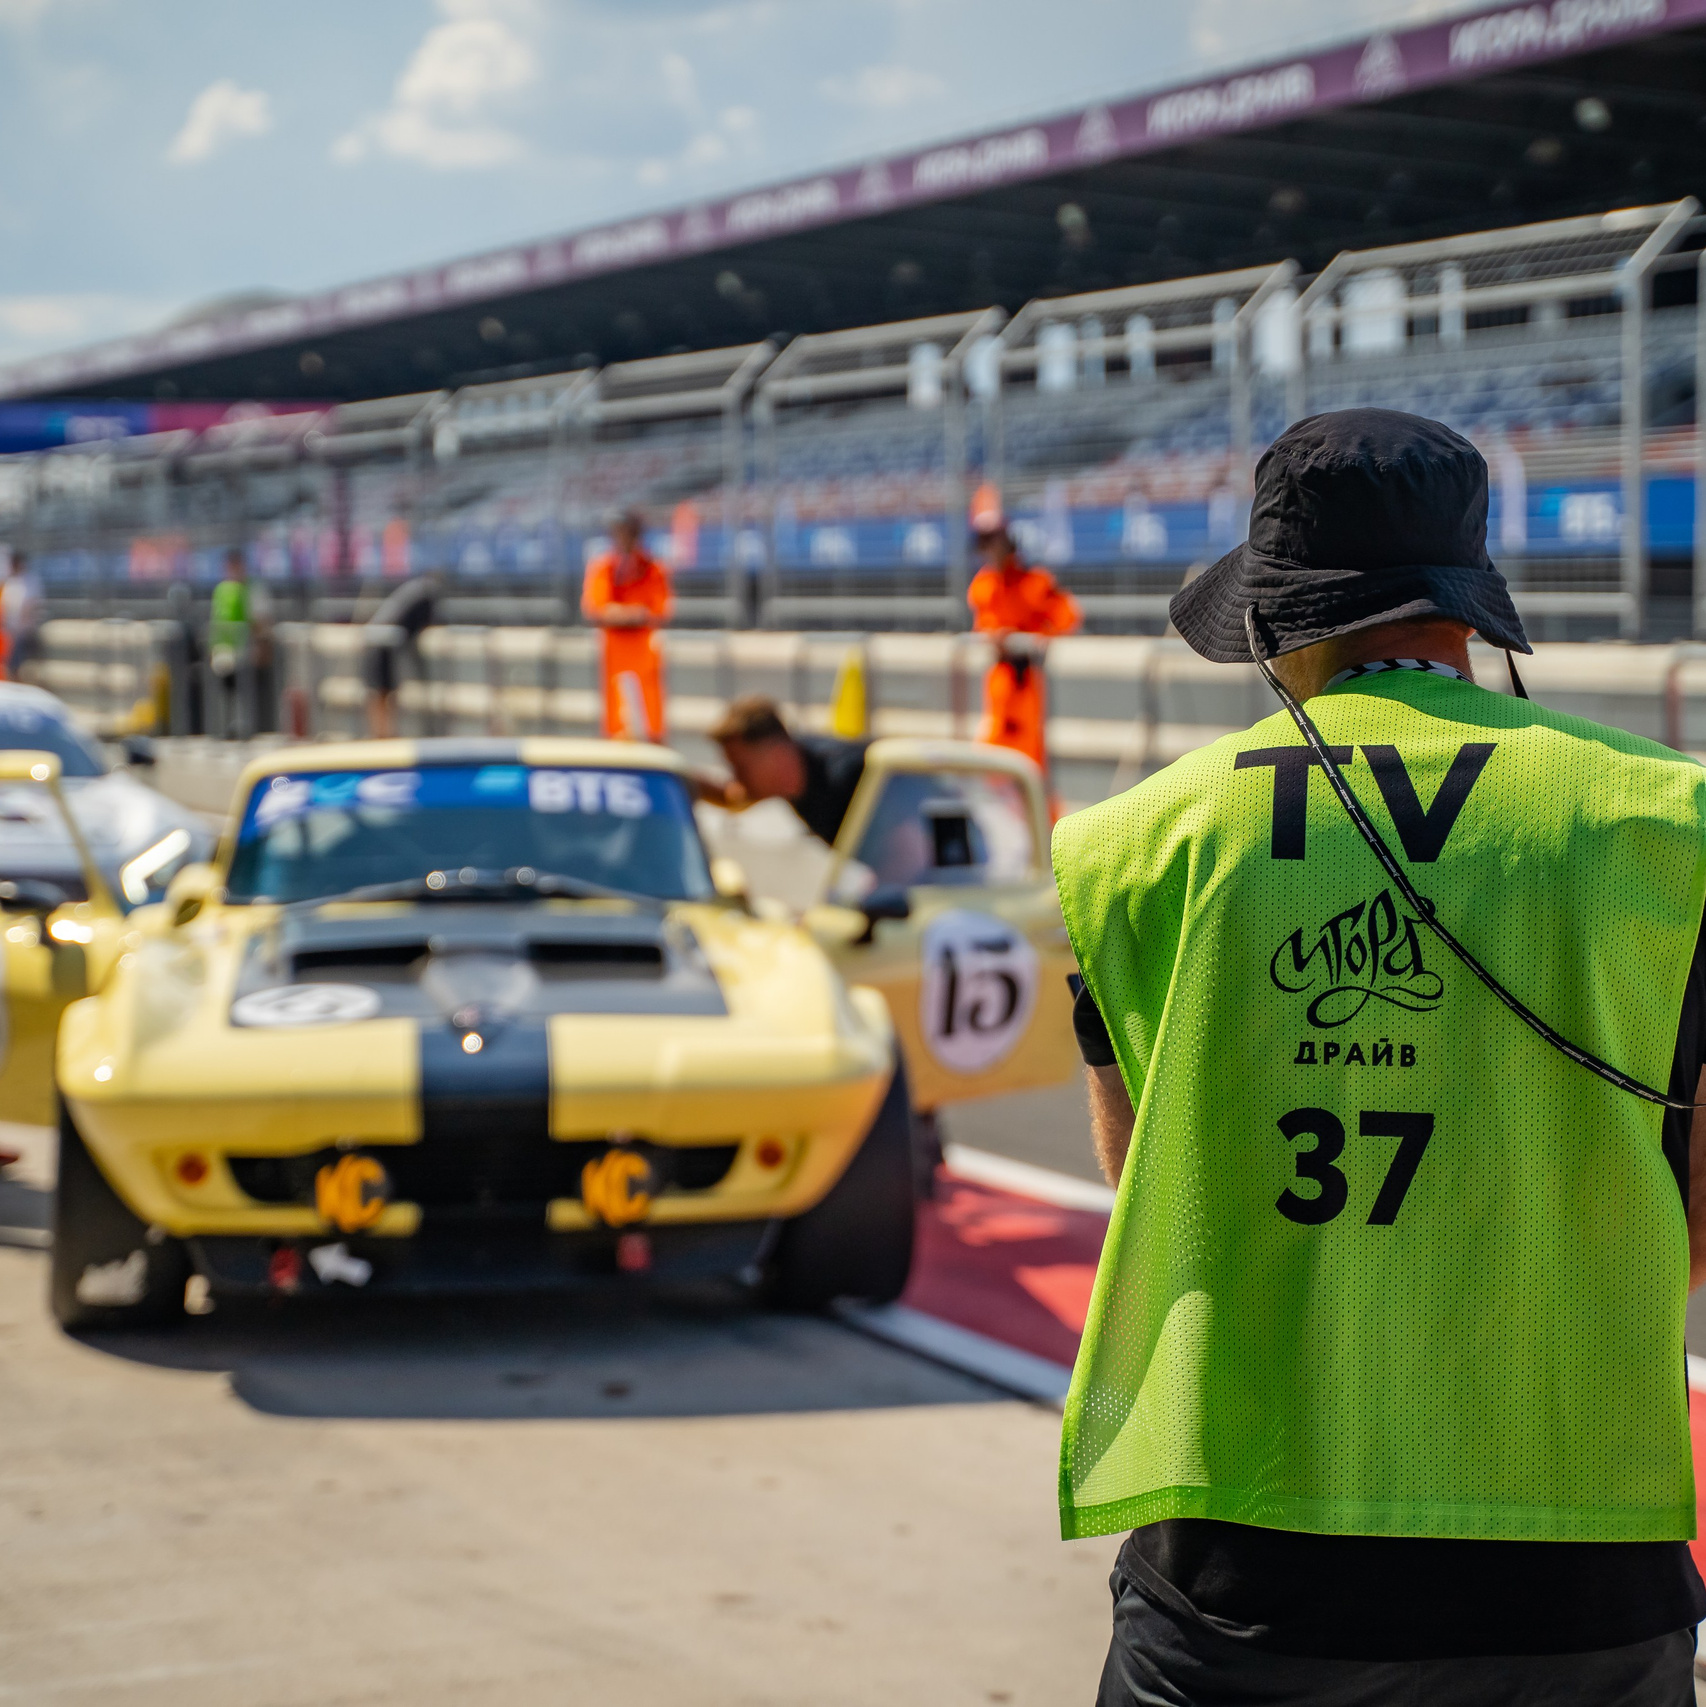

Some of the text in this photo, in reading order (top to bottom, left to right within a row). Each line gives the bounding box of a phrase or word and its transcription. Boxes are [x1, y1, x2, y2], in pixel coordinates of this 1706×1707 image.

[1234, 743, 1495, 863] TV
[938, 935, 1019, 1037] 15
[1294, 1038, 1416, 1067] ДРАЙВ
[1275, 1107, 1434, 1225] 37
